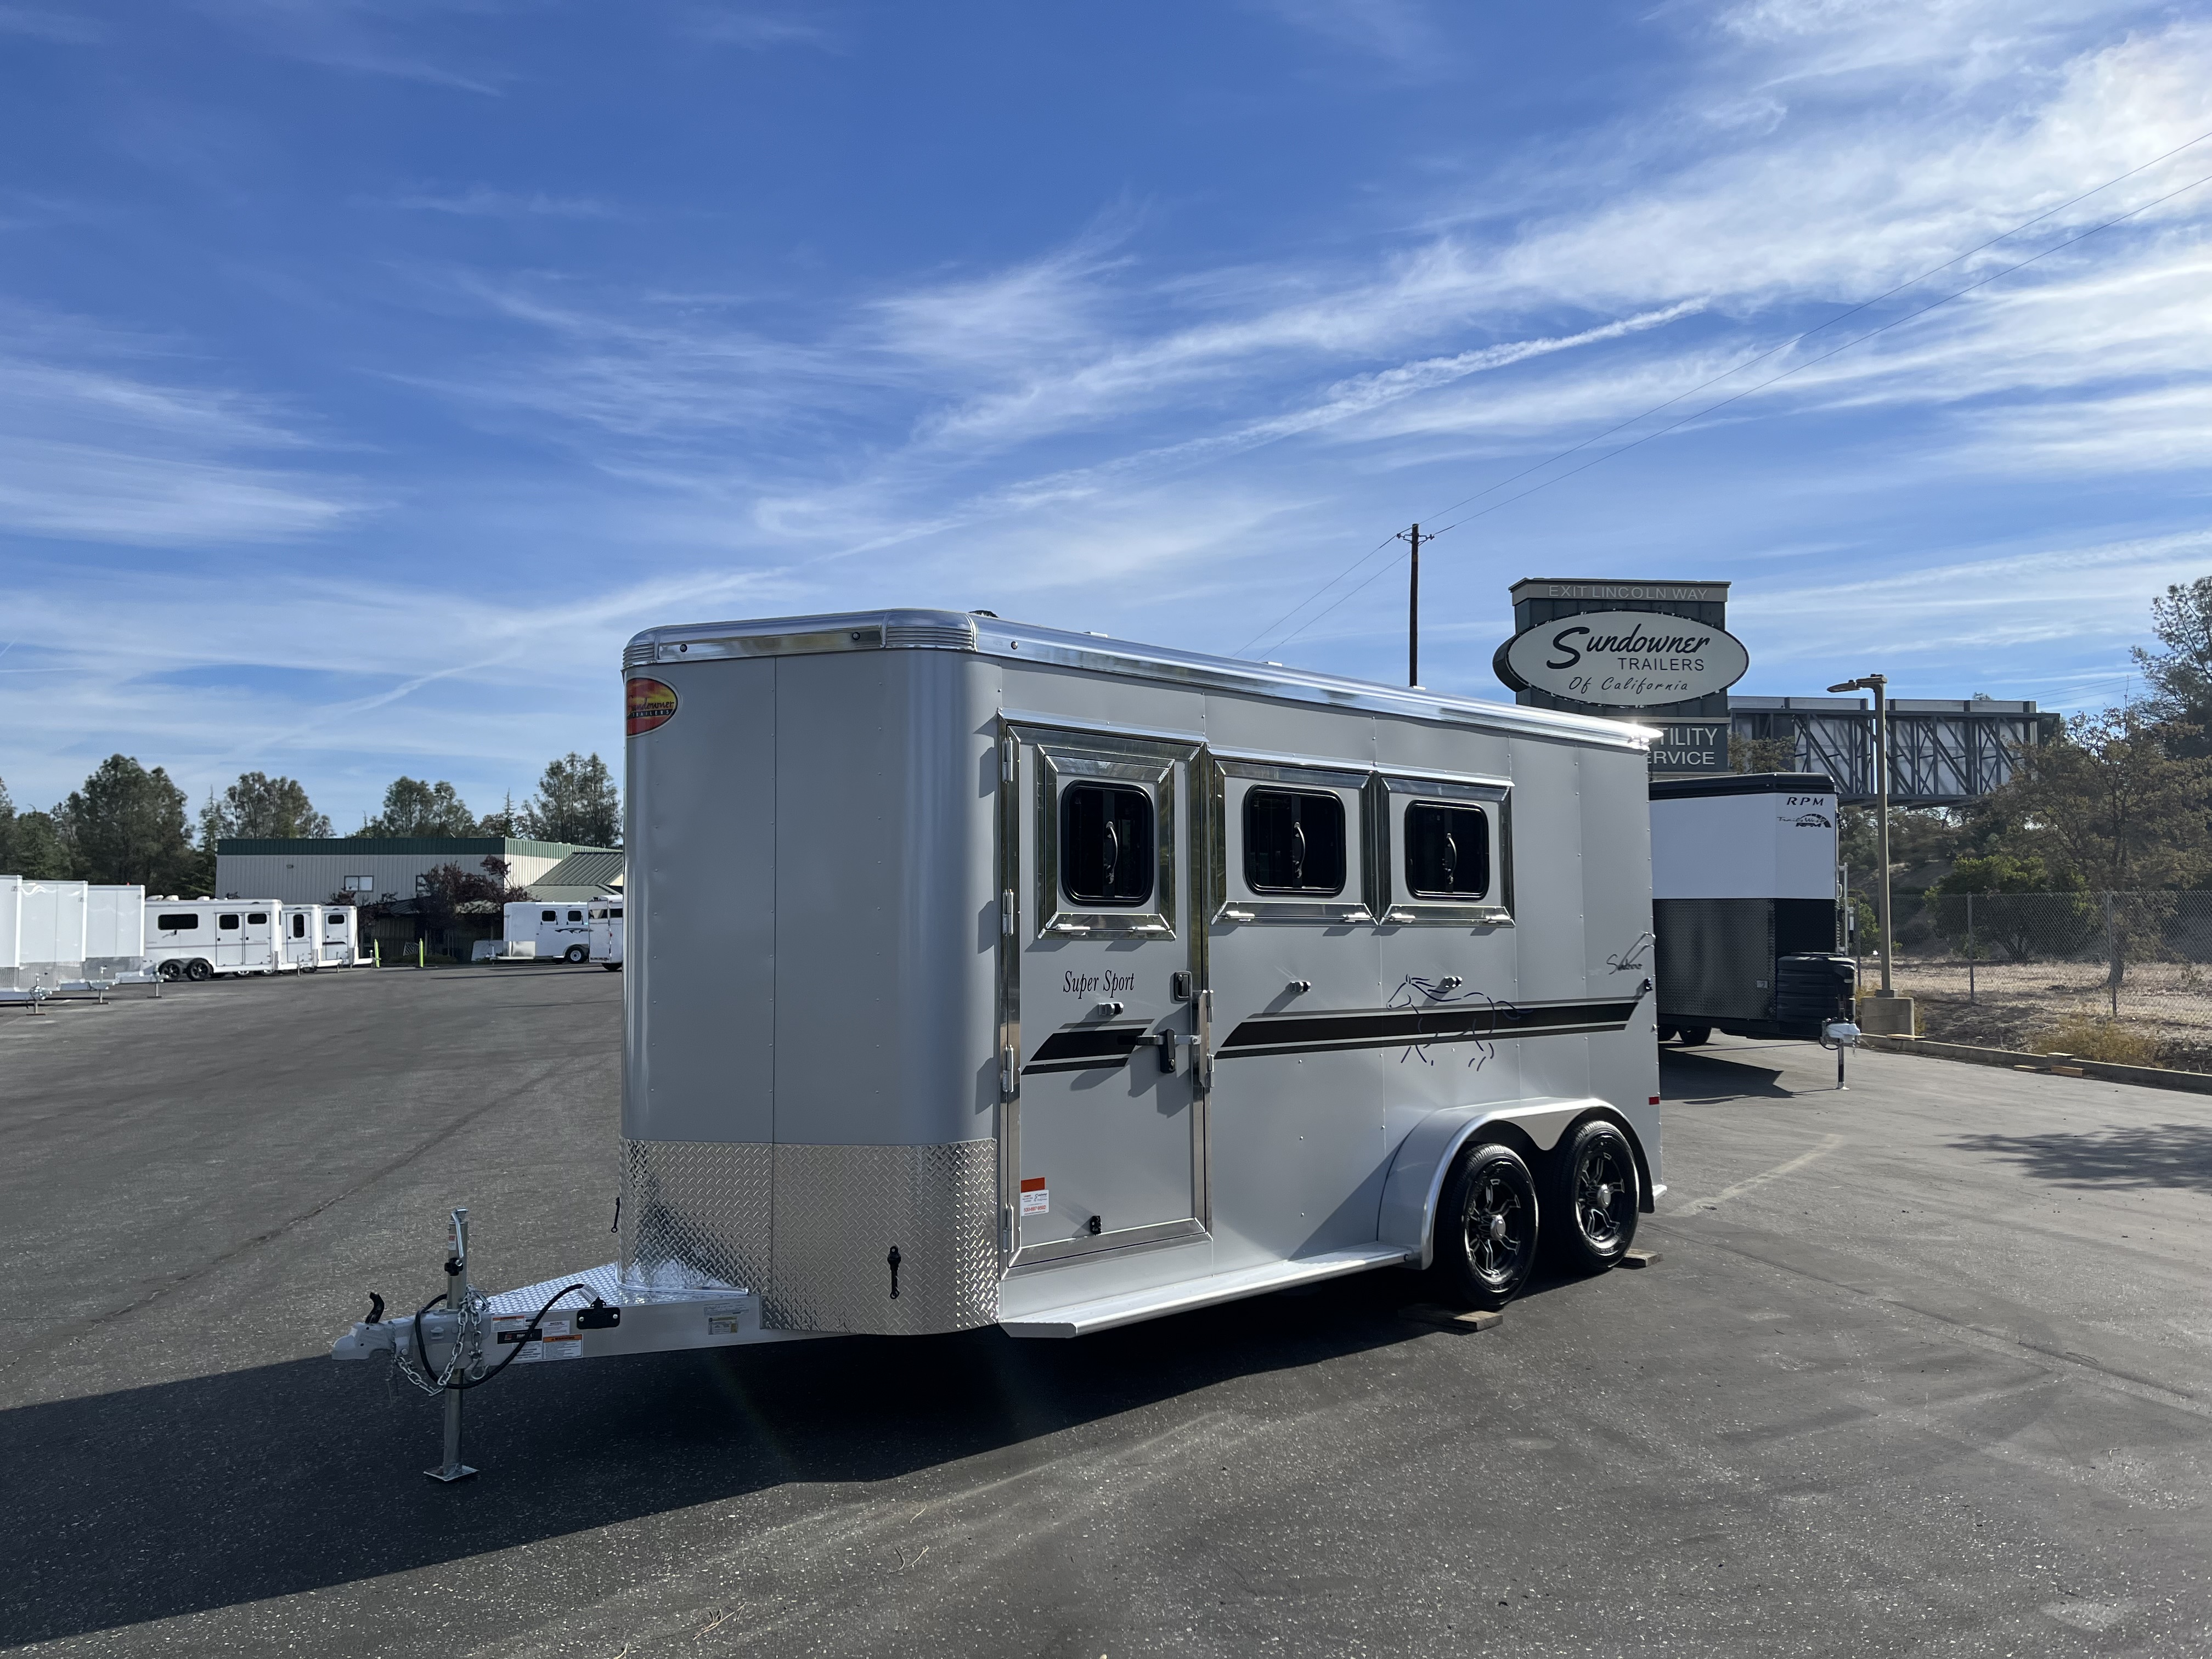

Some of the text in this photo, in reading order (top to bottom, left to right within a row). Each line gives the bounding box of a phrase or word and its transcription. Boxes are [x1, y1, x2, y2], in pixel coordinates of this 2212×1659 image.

[1549, 585, 1708, 600] EXIT LINCOLN WAY
[1546, 623, 1710, 669] Sundowner
[1618, 658, 1705, 671] TRAILERS
[1568, 676, 1688, 695] Of California
[1655, 727, 1718, 746] TILITY
[1786, 797, 1824, 806] RPM
[1063, 969, 1135, 999] Super Sport
